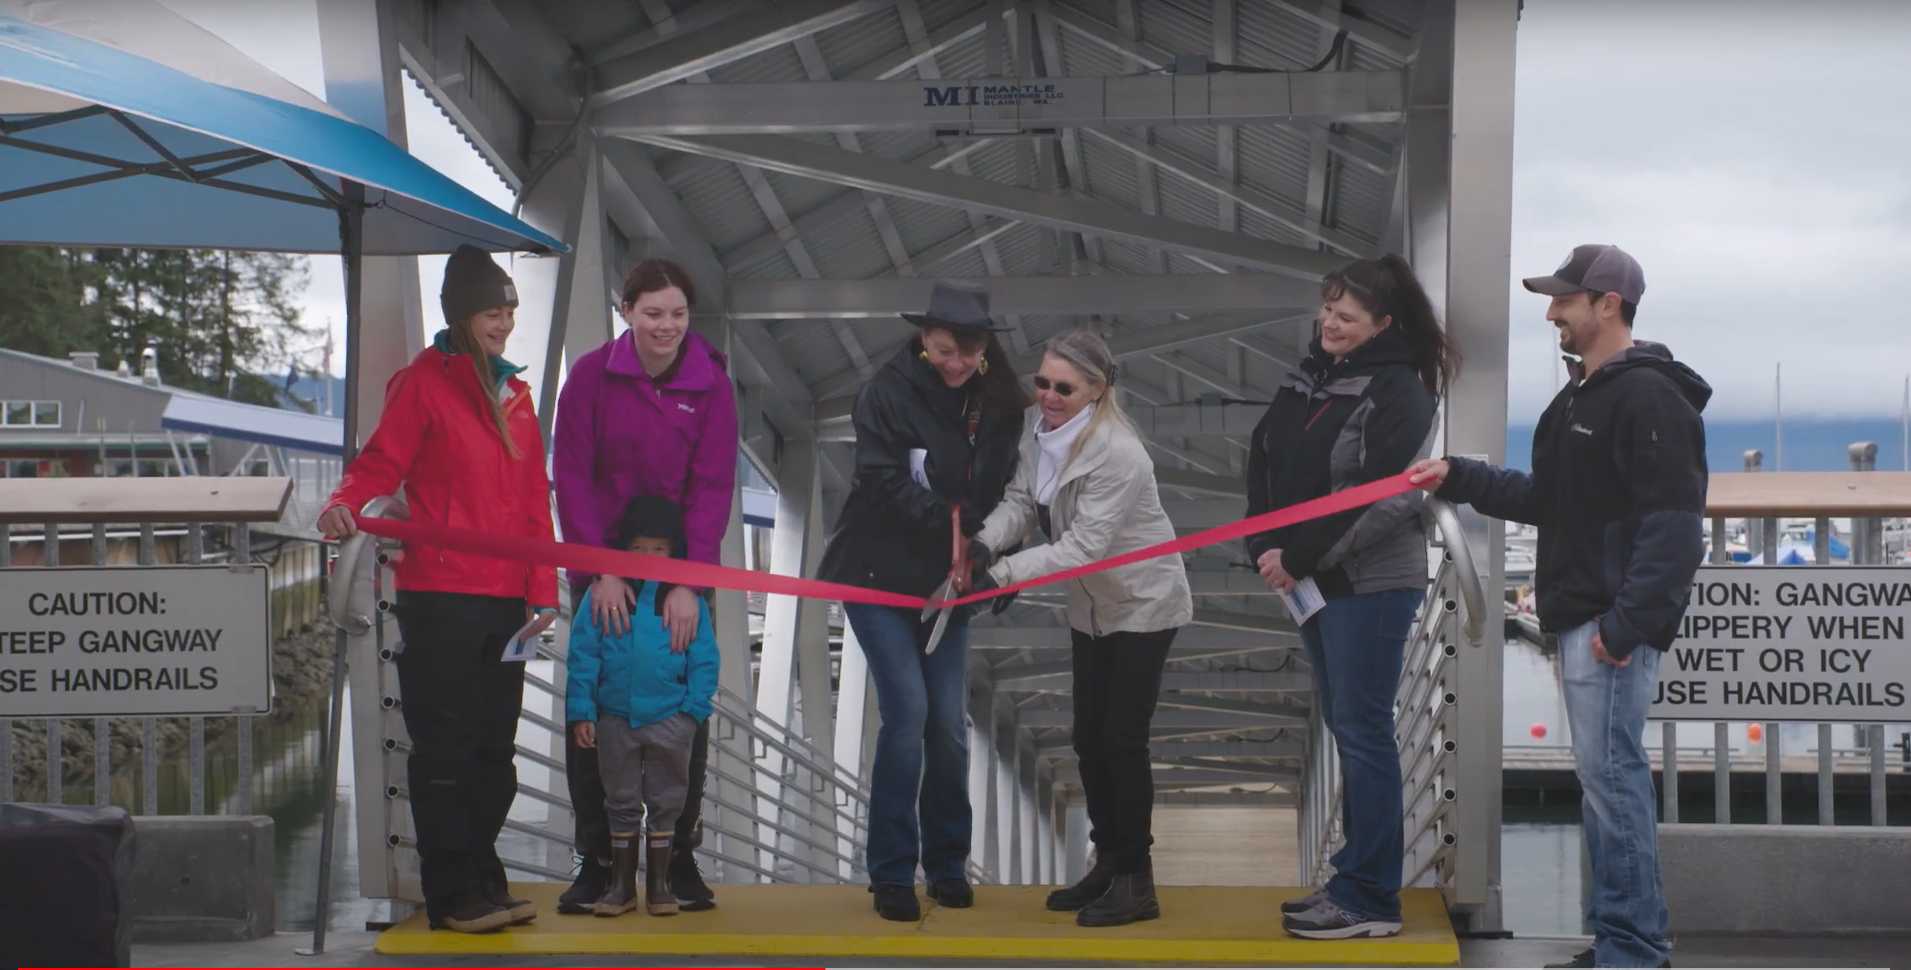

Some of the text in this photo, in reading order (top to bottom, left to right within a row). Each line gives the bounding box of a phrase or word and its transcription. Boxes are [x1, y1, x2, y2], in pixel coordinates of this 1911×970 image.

[923, 86, 980, 107] MI
[983, 84, 1055, 94] MANTLE
[28, 591, 167, 616] CAUTION:
[1775, 582, 1911, 607] GANGWA
[1675, 615, 1905, 640] IPPERY WHEN
[0, 628, 223, 655] TEEP GANGWAY
[1674, 647, 1872, 674] WET OR ICY
[0, 666, 219, 693] SE HANDRAILS
[1722, 681, 1906, 708] HANDRAILS
